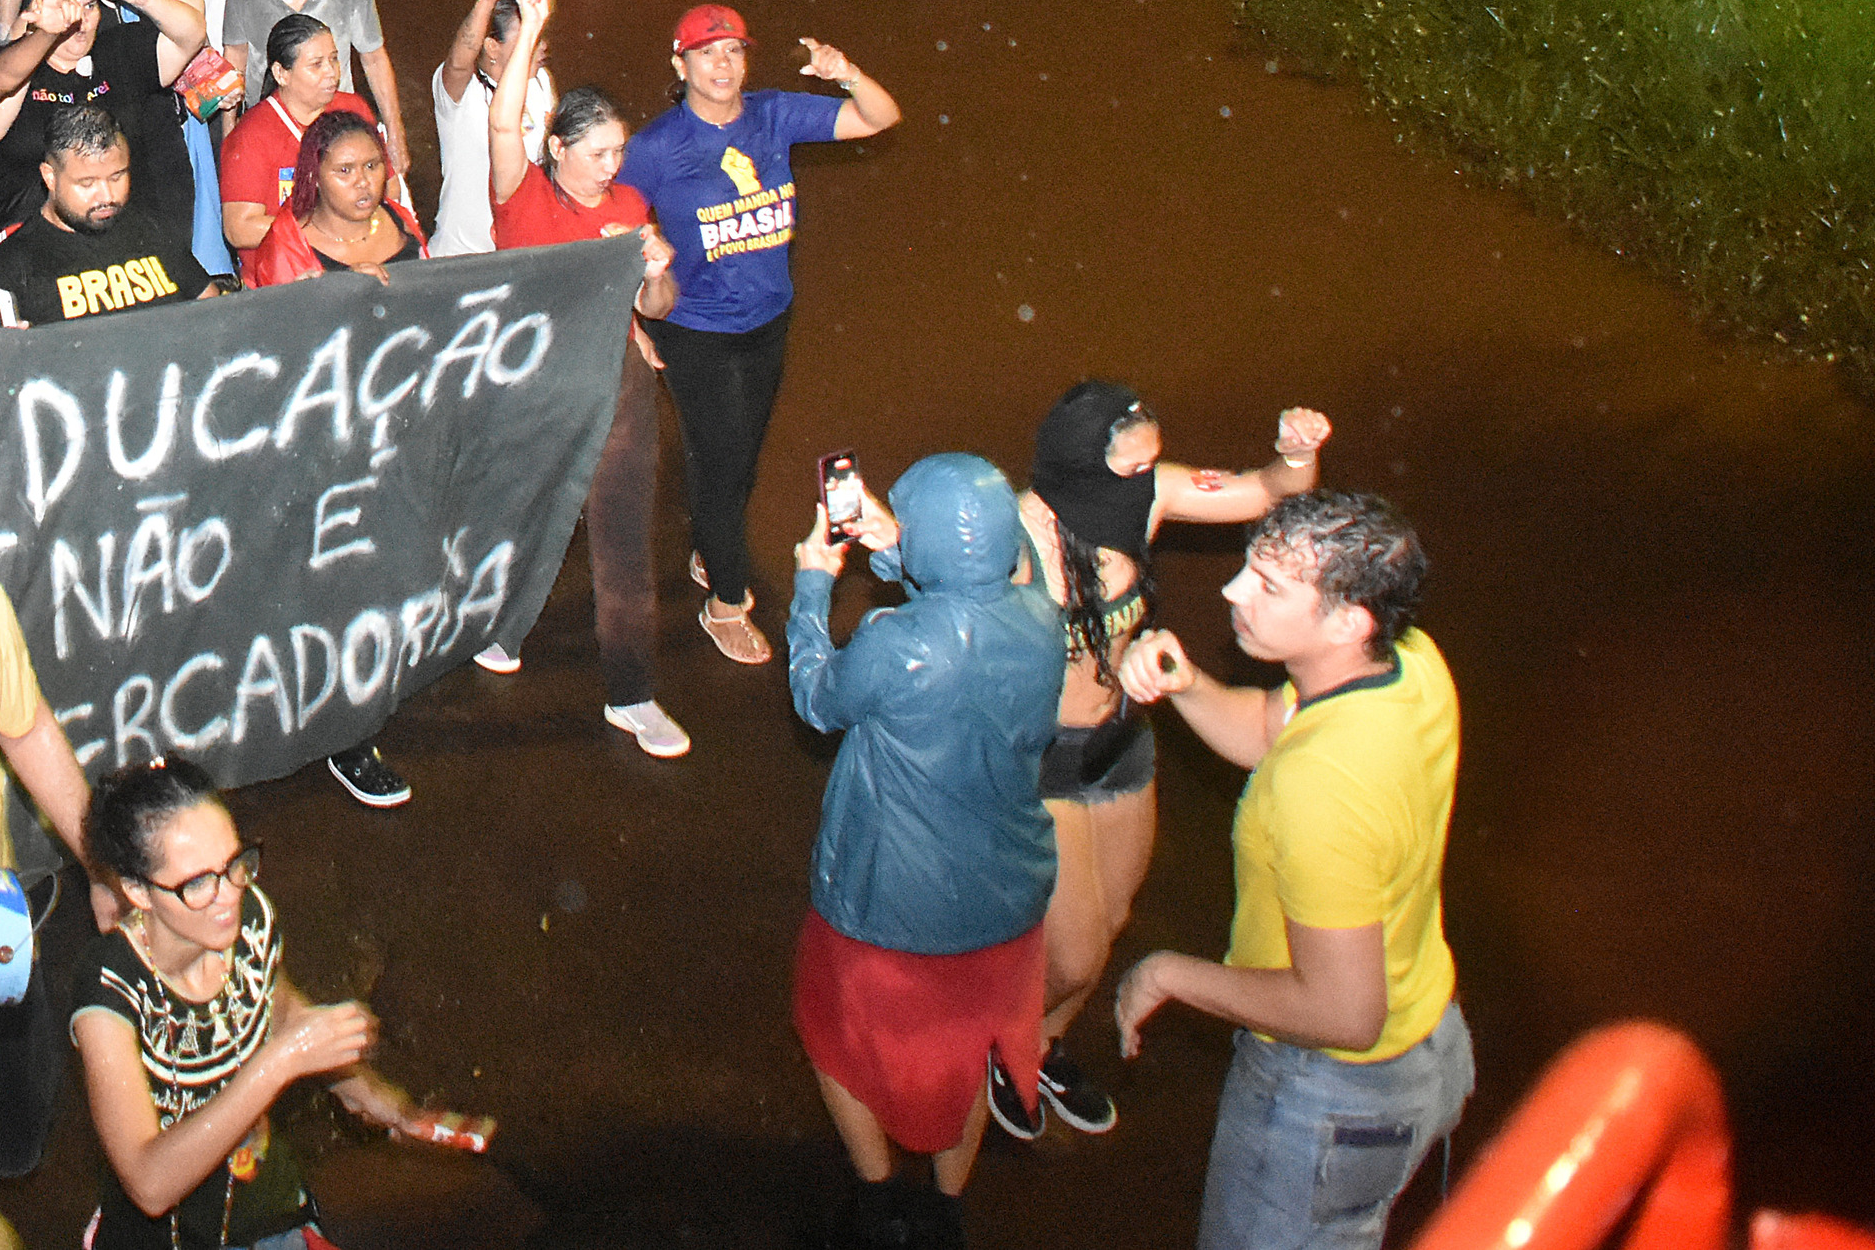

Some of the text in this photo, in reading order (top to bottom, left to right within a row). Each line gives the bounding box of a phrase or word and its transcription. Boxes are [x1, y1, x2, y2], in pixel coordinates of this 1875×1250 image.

[32, 89, 56, 102] não
[696, 181, 796, 223] QUEM MANDA NO
[720, 240, 746, 257] POVO
[56, 254, 178, 320] BRASIL
[52, 491, 233, 661] NÃO
[55, 535, 515, 766] ERCADORIA
